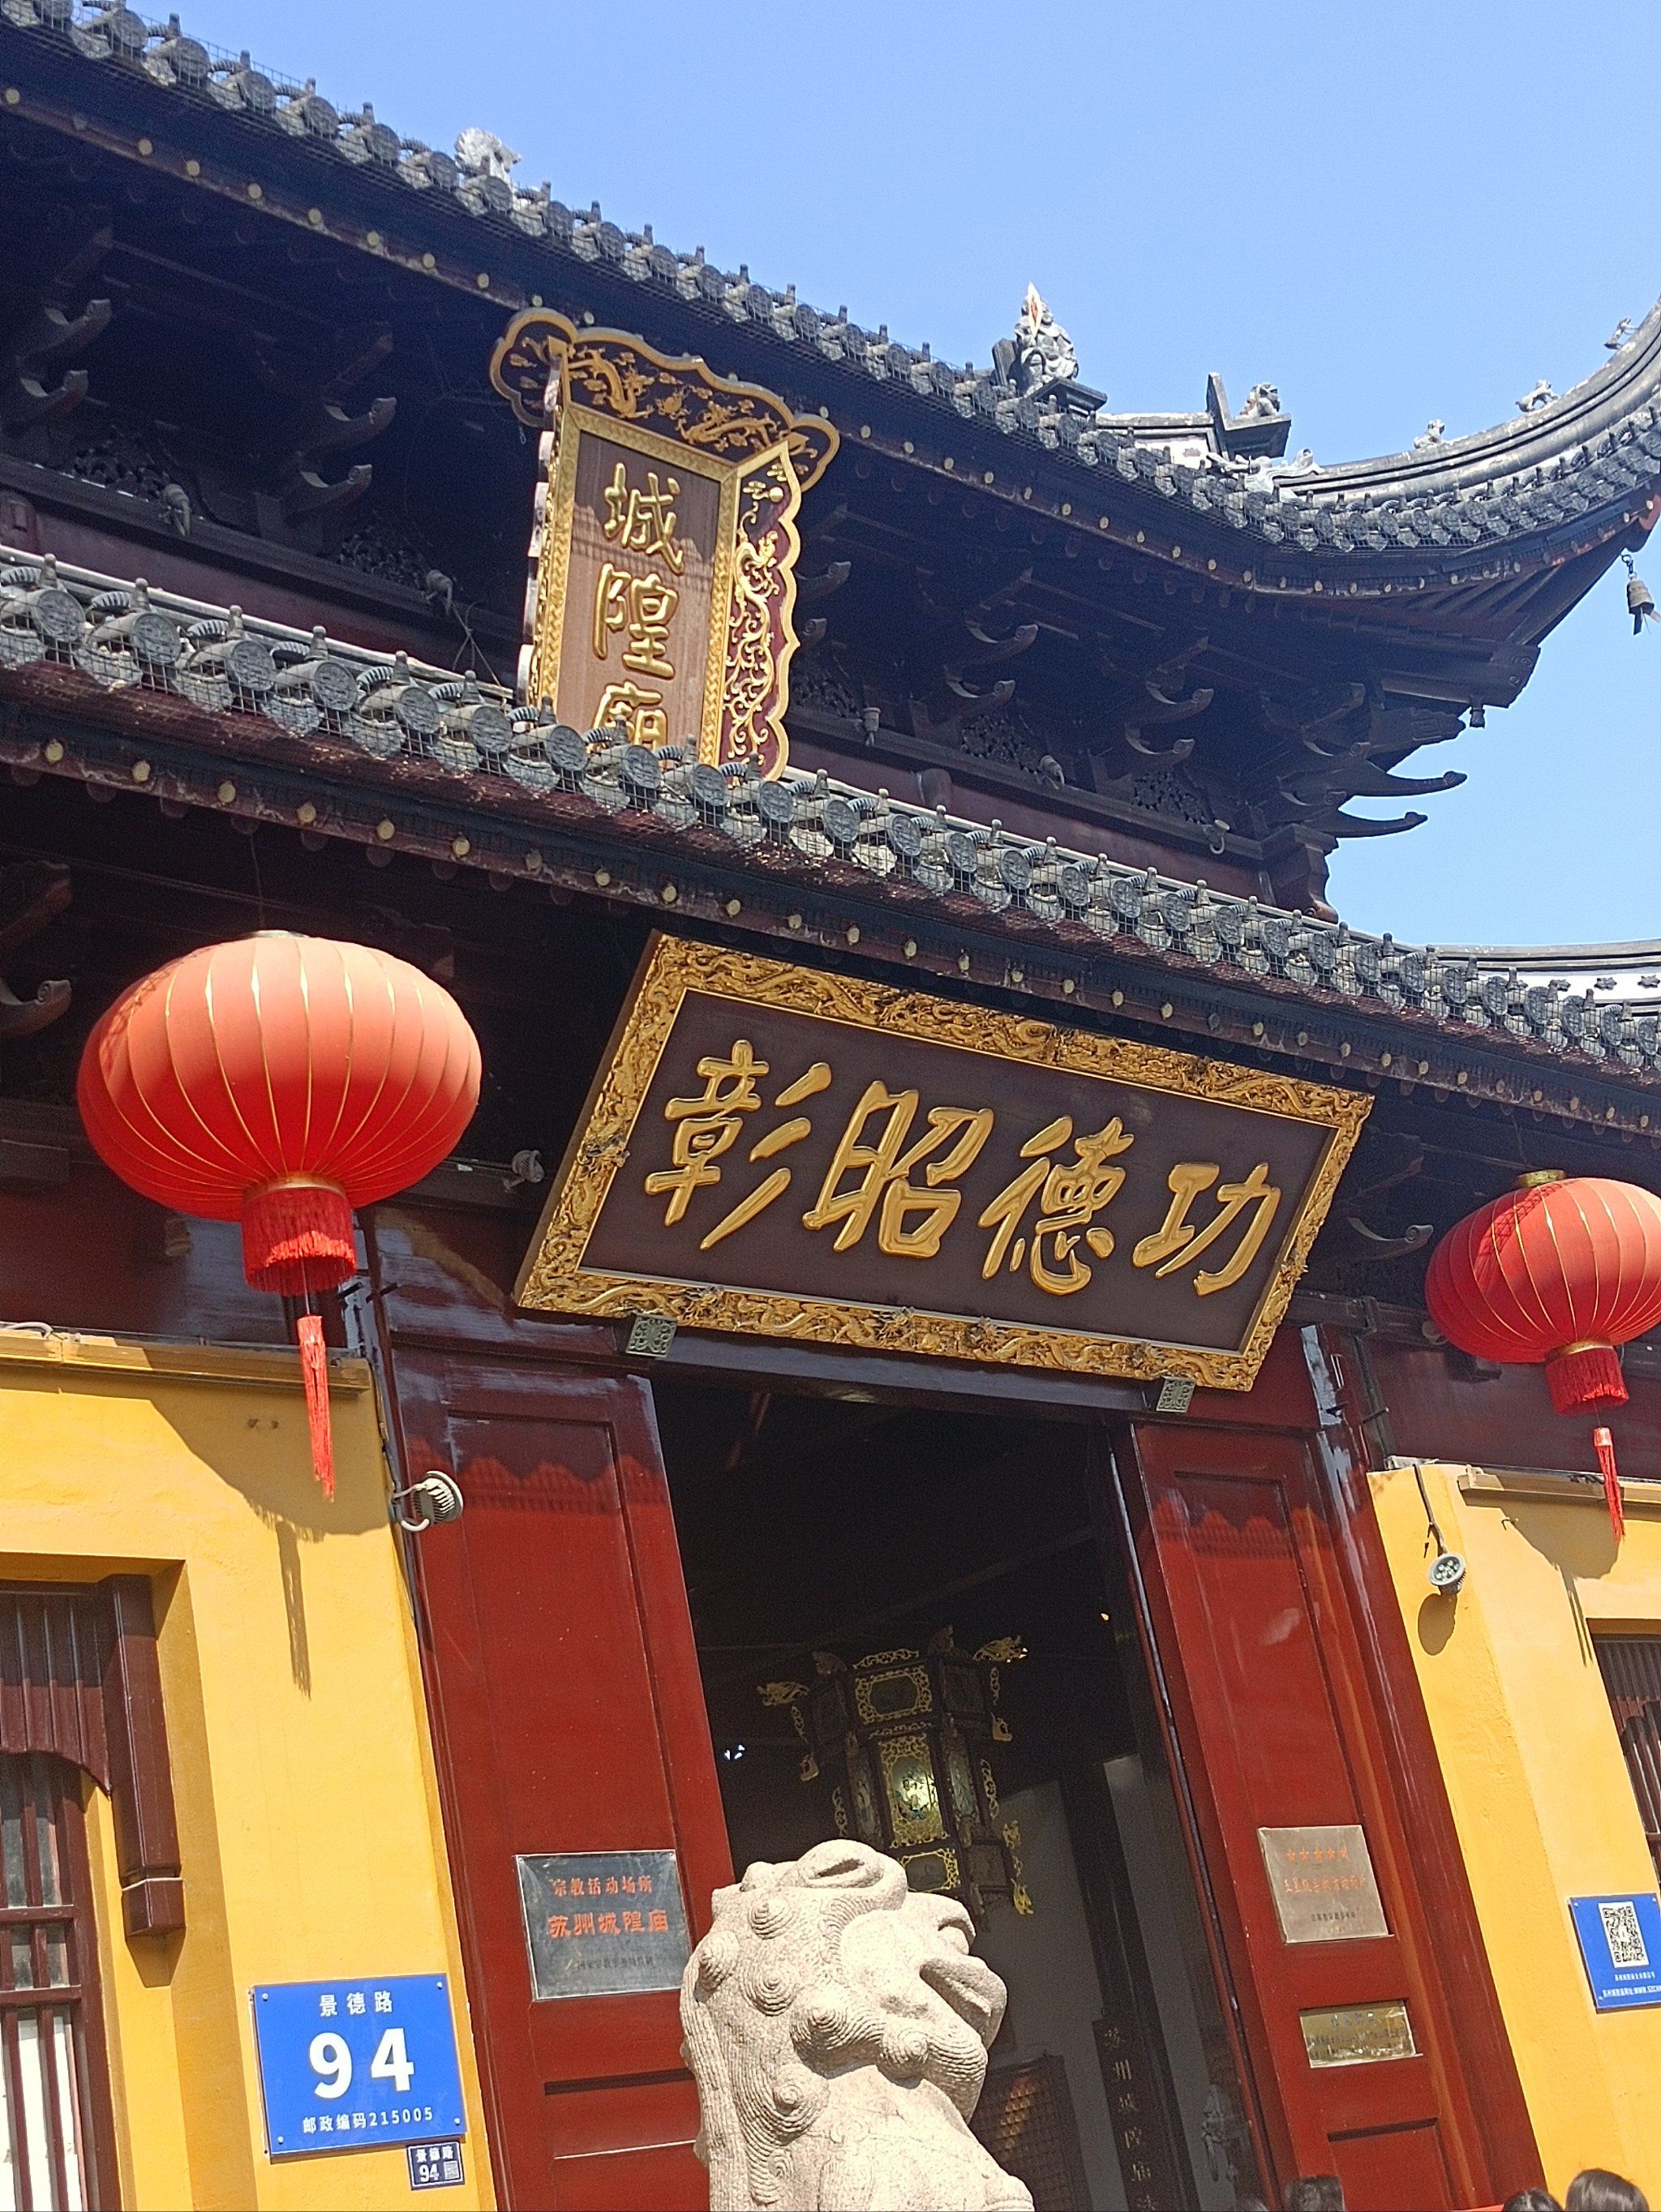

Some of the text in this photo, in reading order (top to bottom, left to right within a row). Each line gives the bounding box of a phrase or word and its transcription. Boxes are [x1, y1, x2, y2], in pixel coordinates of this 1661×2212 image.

[552, 1875, 653, 1897] 宗教活动场所
[547, 1910, 669, 1939] 苏州城隍庙
[320, 1991, 393, 2017] 景德路
[309, 2027, 414, 2098] 94
[303, 2107, 434, 2134] 邮政编码215005
[419, 2163, 440, 2182] 94
